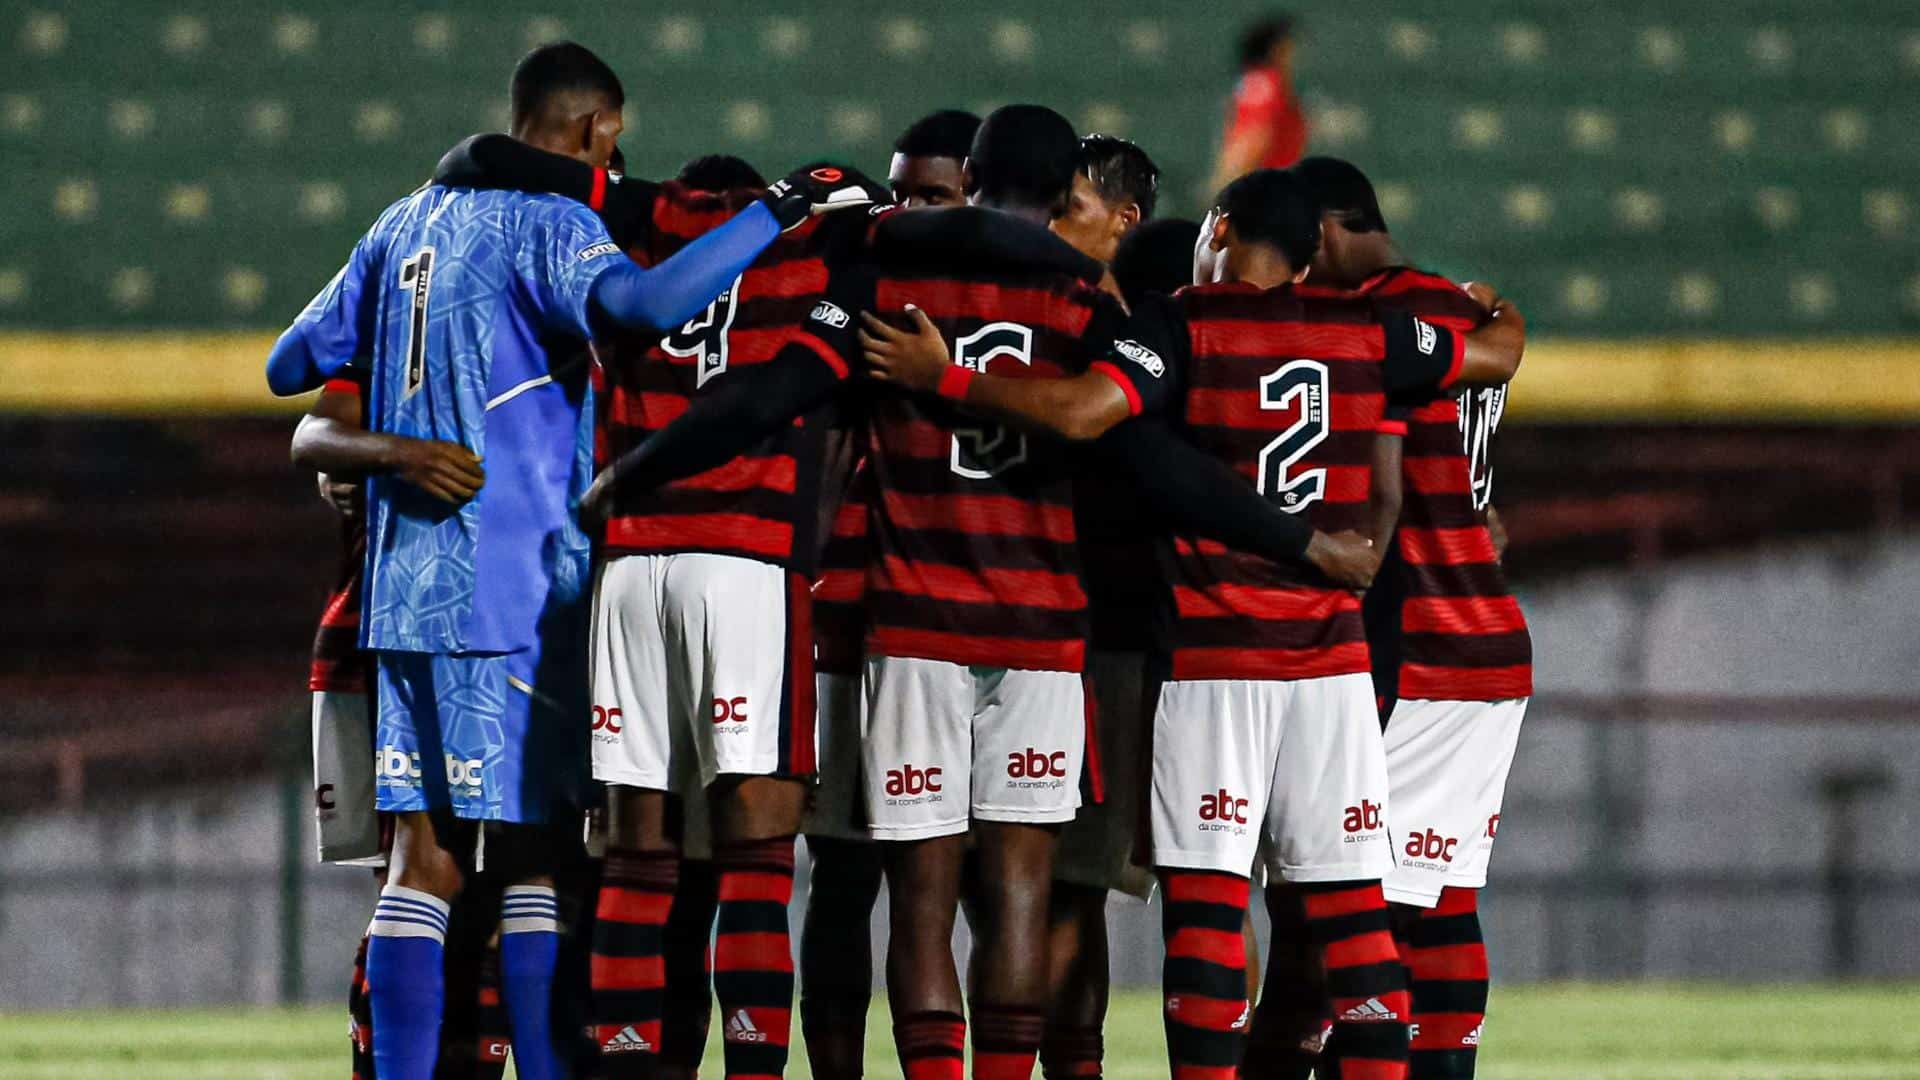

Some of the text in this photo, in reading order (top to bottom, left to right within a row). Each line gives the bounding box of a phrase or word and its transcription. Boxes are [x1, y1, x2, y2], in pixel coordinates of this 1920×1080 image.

[399, 245, 436, 401] 1
[1309, 384, 1320, 411] TIM
[1257, 359, 1329, 514] 2
[886, 764, 942, 796] abc
[1008, 748, 1066, 778] abc
[1199, 789, 1249, 824] abc
[1405, 827, 1458, 862] abc
